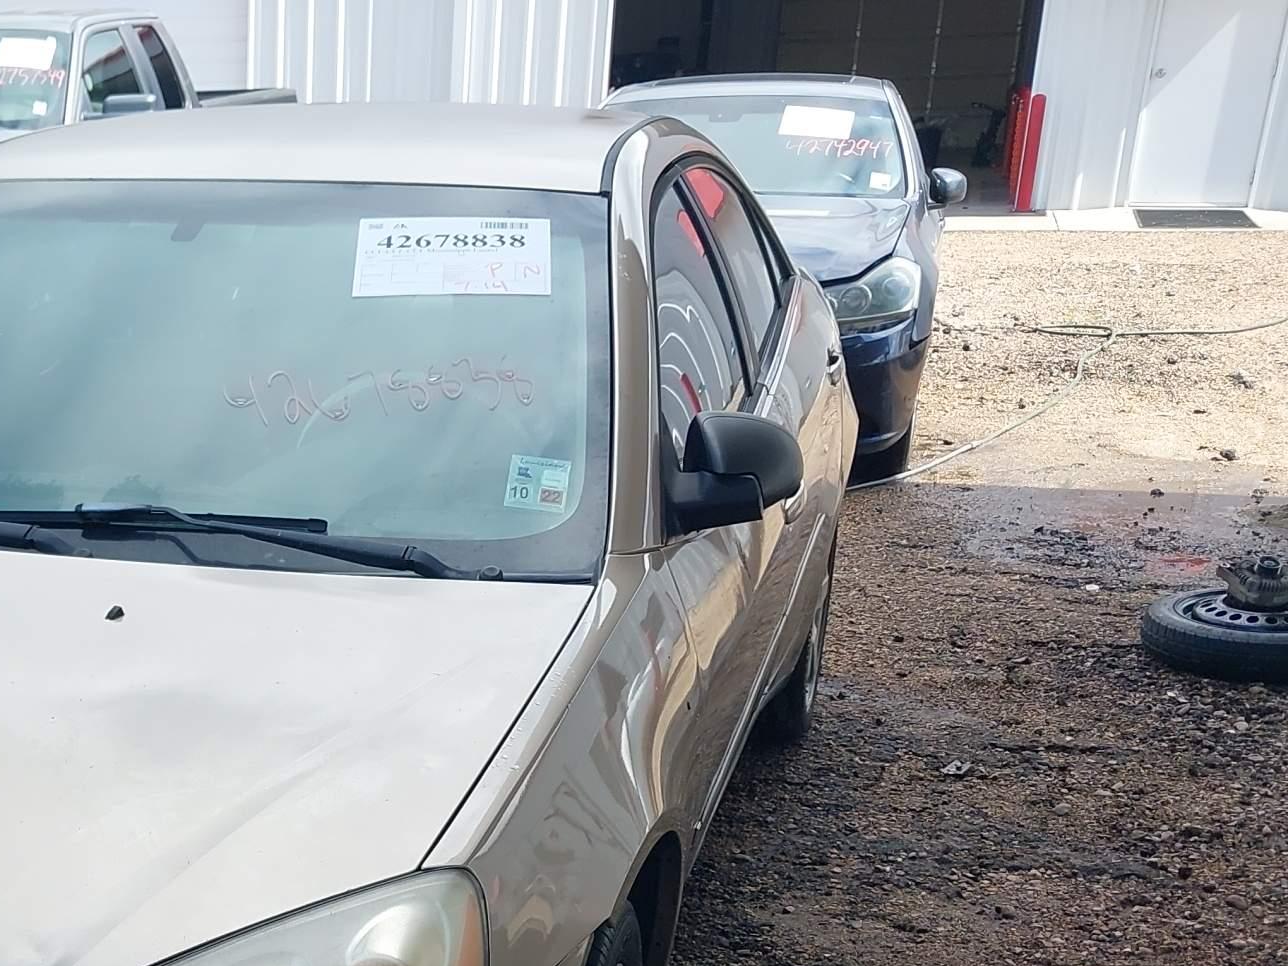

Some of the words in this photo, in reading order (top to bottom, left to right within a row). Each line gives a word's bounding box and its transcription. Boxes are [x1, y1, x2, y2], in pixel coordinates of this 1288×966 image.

[785, 139, 895, 159] 42742947
[377, 234, 526, 248] 42678838
[510, 486, 529, 499] 10
[542, 489, 562, 503] 22
